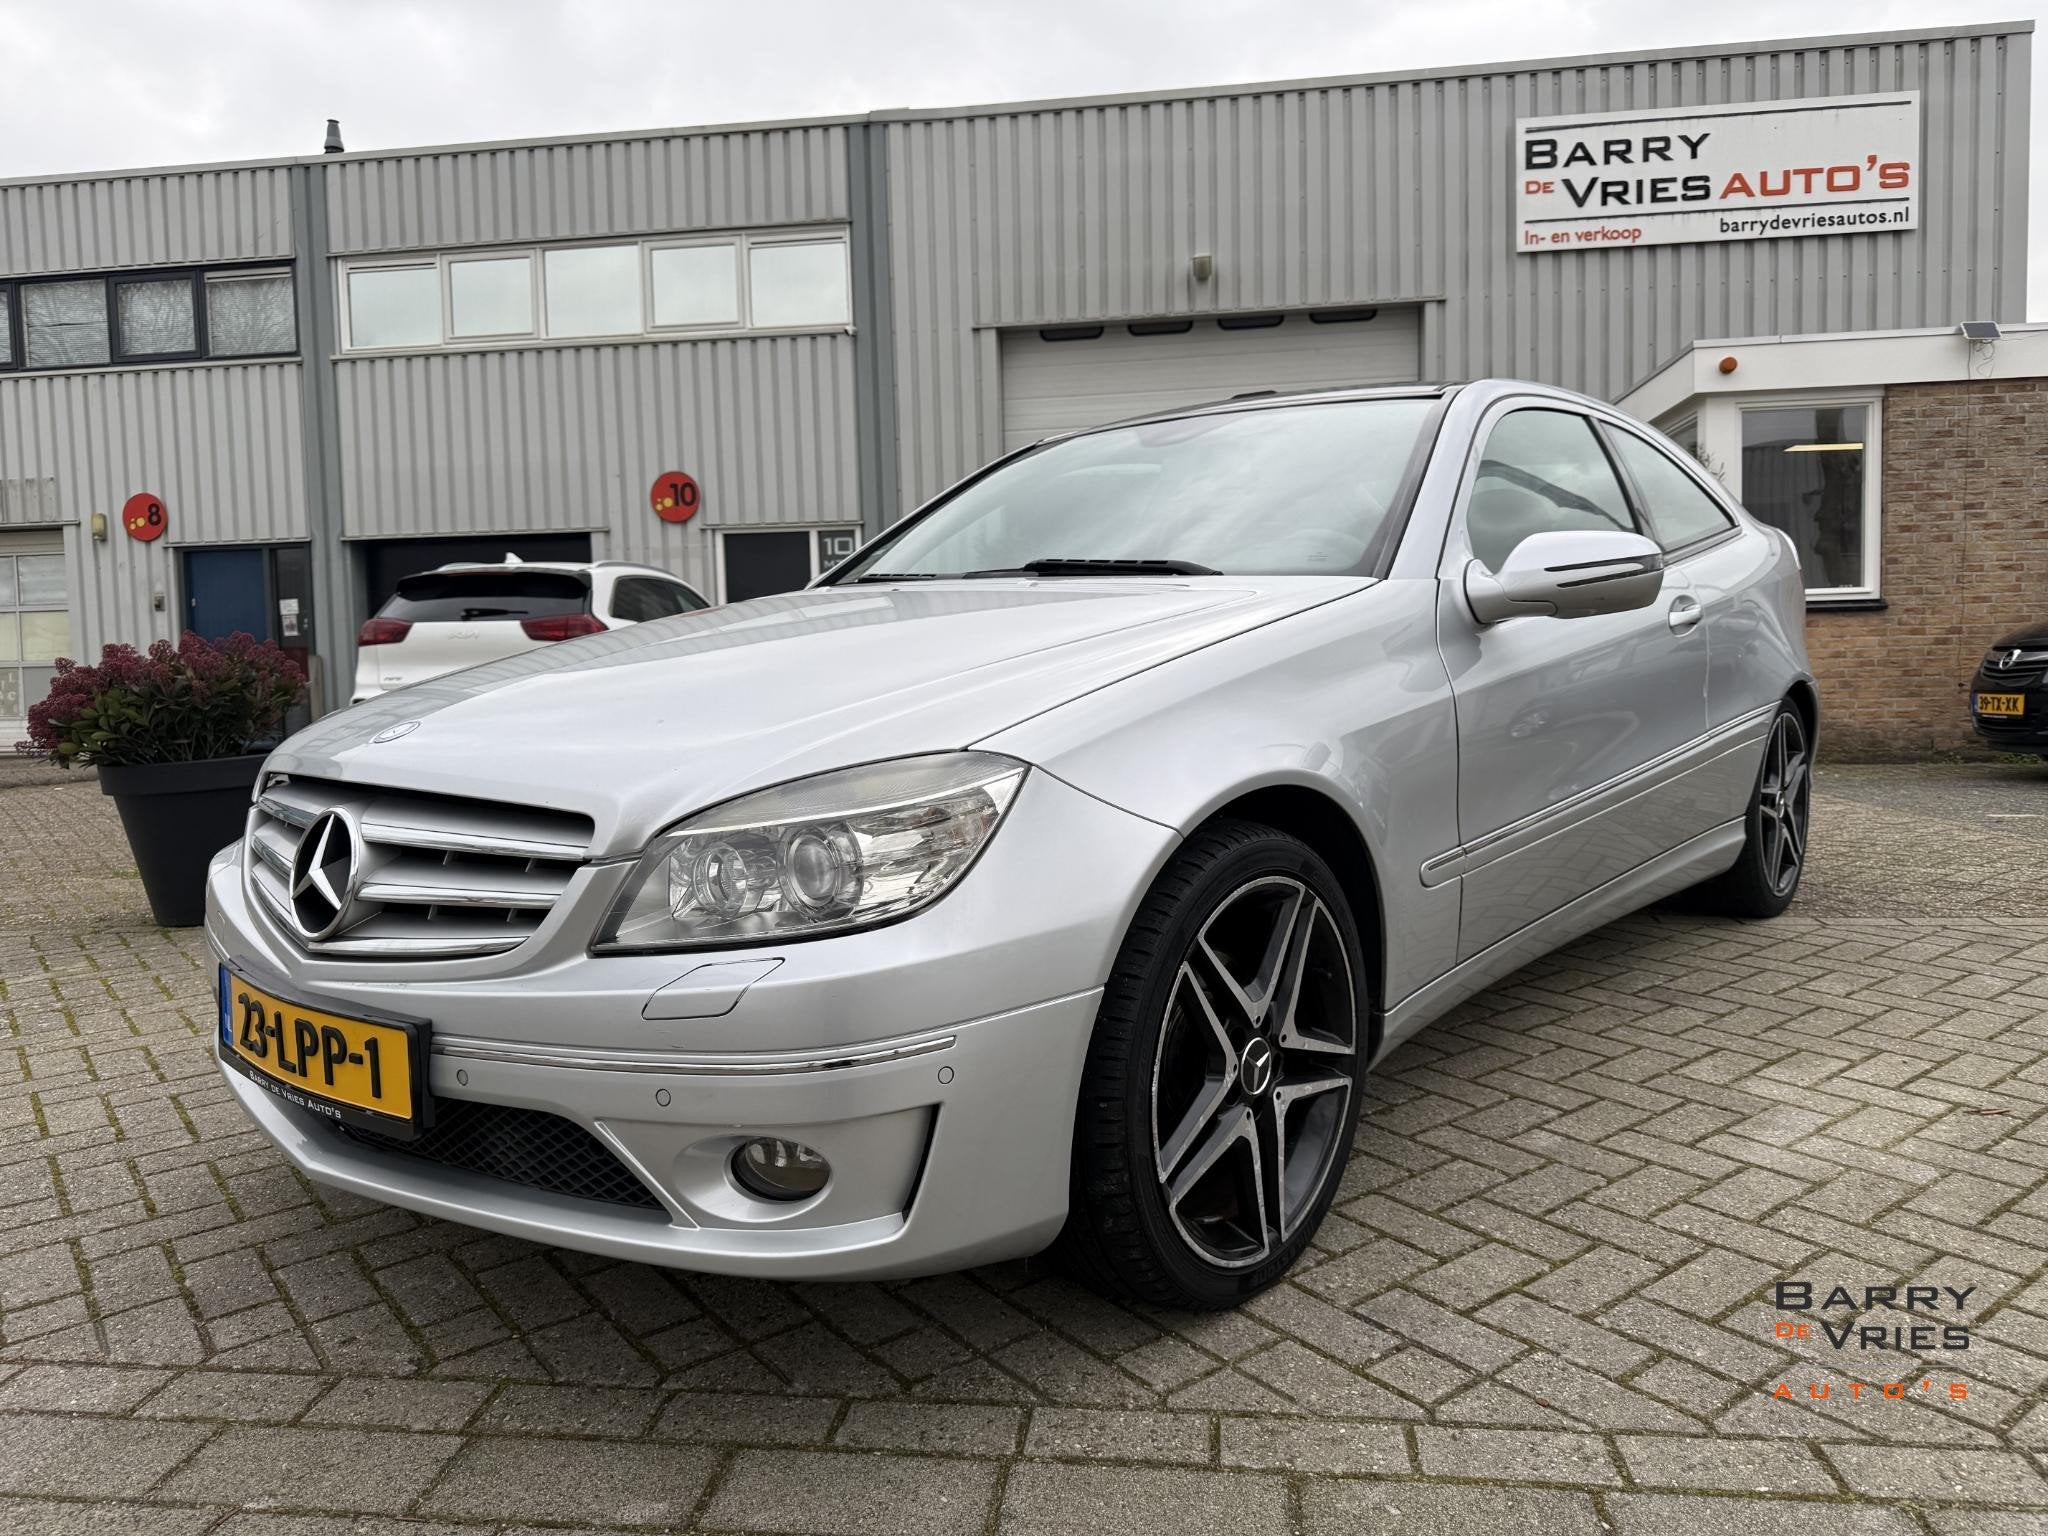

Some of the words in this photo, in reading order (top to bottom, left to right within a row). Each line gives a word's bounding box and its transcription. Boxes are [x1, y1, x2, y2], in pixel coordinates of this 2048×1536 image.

[1525, 132, 1711, 170] BARRY
[1525, 181, 1555, 195] DE
[1561, 175, 1711, 208] VRIES
[1719, 154, 1911, 200] AUTO'S
[1719, 206, 1910, 236] barrydevriesautos.nl
[1524, 229, 1546, 246] In-
[1551, 231, 1571, 244] en
[1574, 226, 1642, 244] verkoop
[669, 482, 697, 507] 10
[147, 503, 162, 526] 8
[823, 537, 854, 556] 10
[1978, 696, 2020, 712] 39-TX-XK
[237, 992, 382, 1099] 23-LPP-1
[249, 1070, 269, 1089] BARRY
[281, 1088, 305, 1106] VRIES
[307, 1099, 341, 1119] AUTO'S
